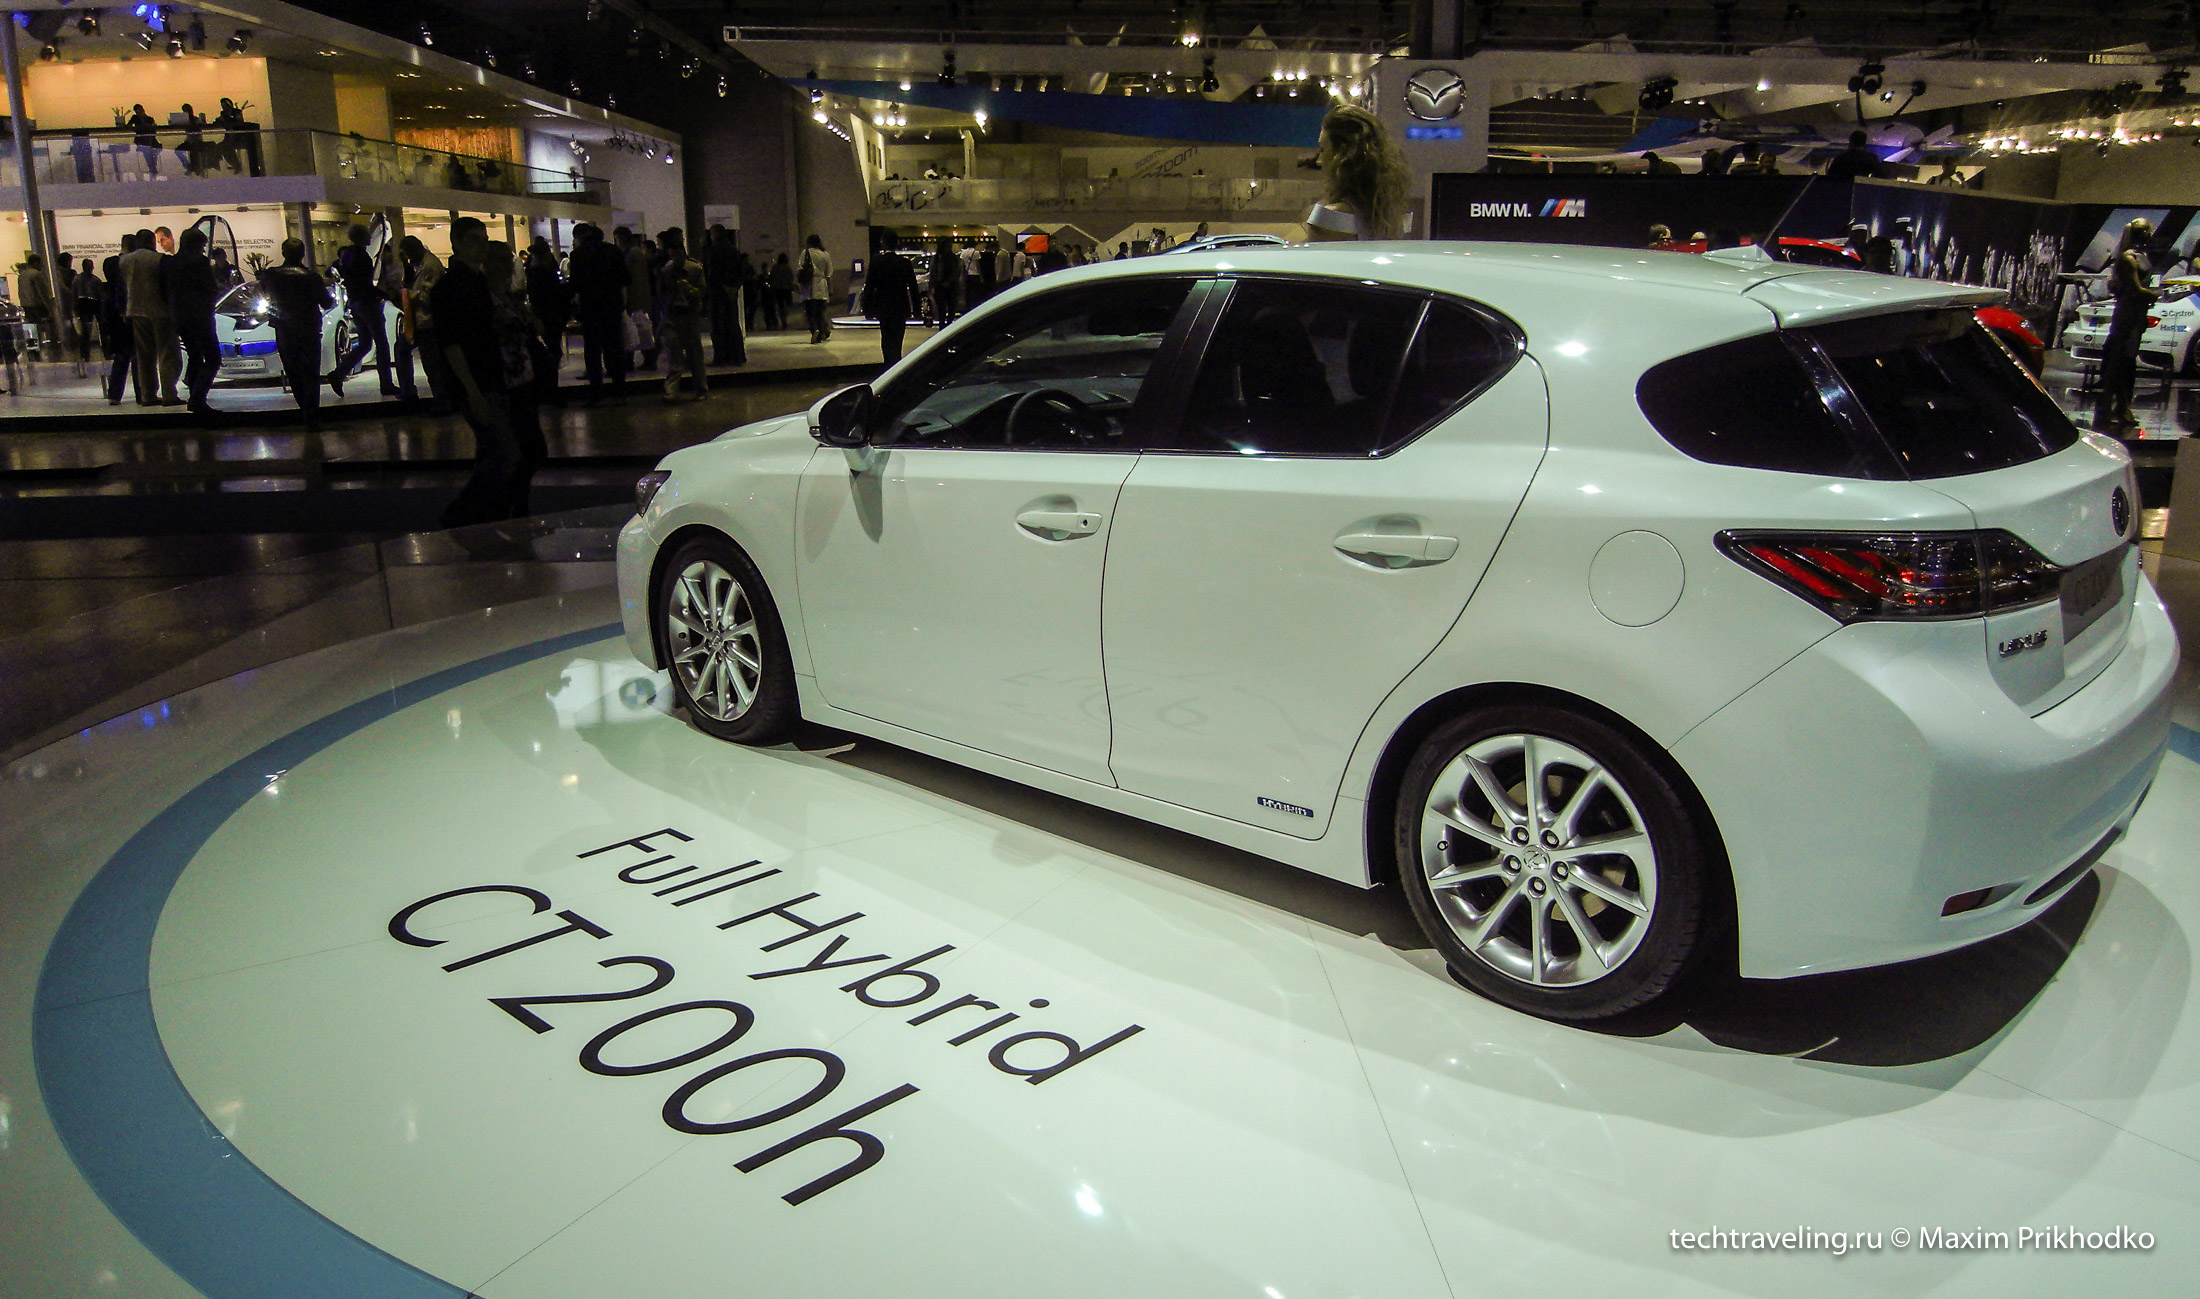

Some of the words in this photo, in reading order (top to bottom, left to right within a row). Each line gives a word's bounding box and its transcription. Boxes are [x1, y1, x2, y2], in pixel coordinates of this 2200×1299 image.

[1470, 203, 1511, 218] BMW
[1513, 203, 1532, 218] M.
[1999, 630, 2048, 655] LEXUS
[1262, 798, 1307, 816] HYBRID
[387, 884, 614, 973] CT
[577, 828, 782, 907] Full
[716, 893, 1144, 1085] Hybrid
[487, 955, 921, 1207] 200h
